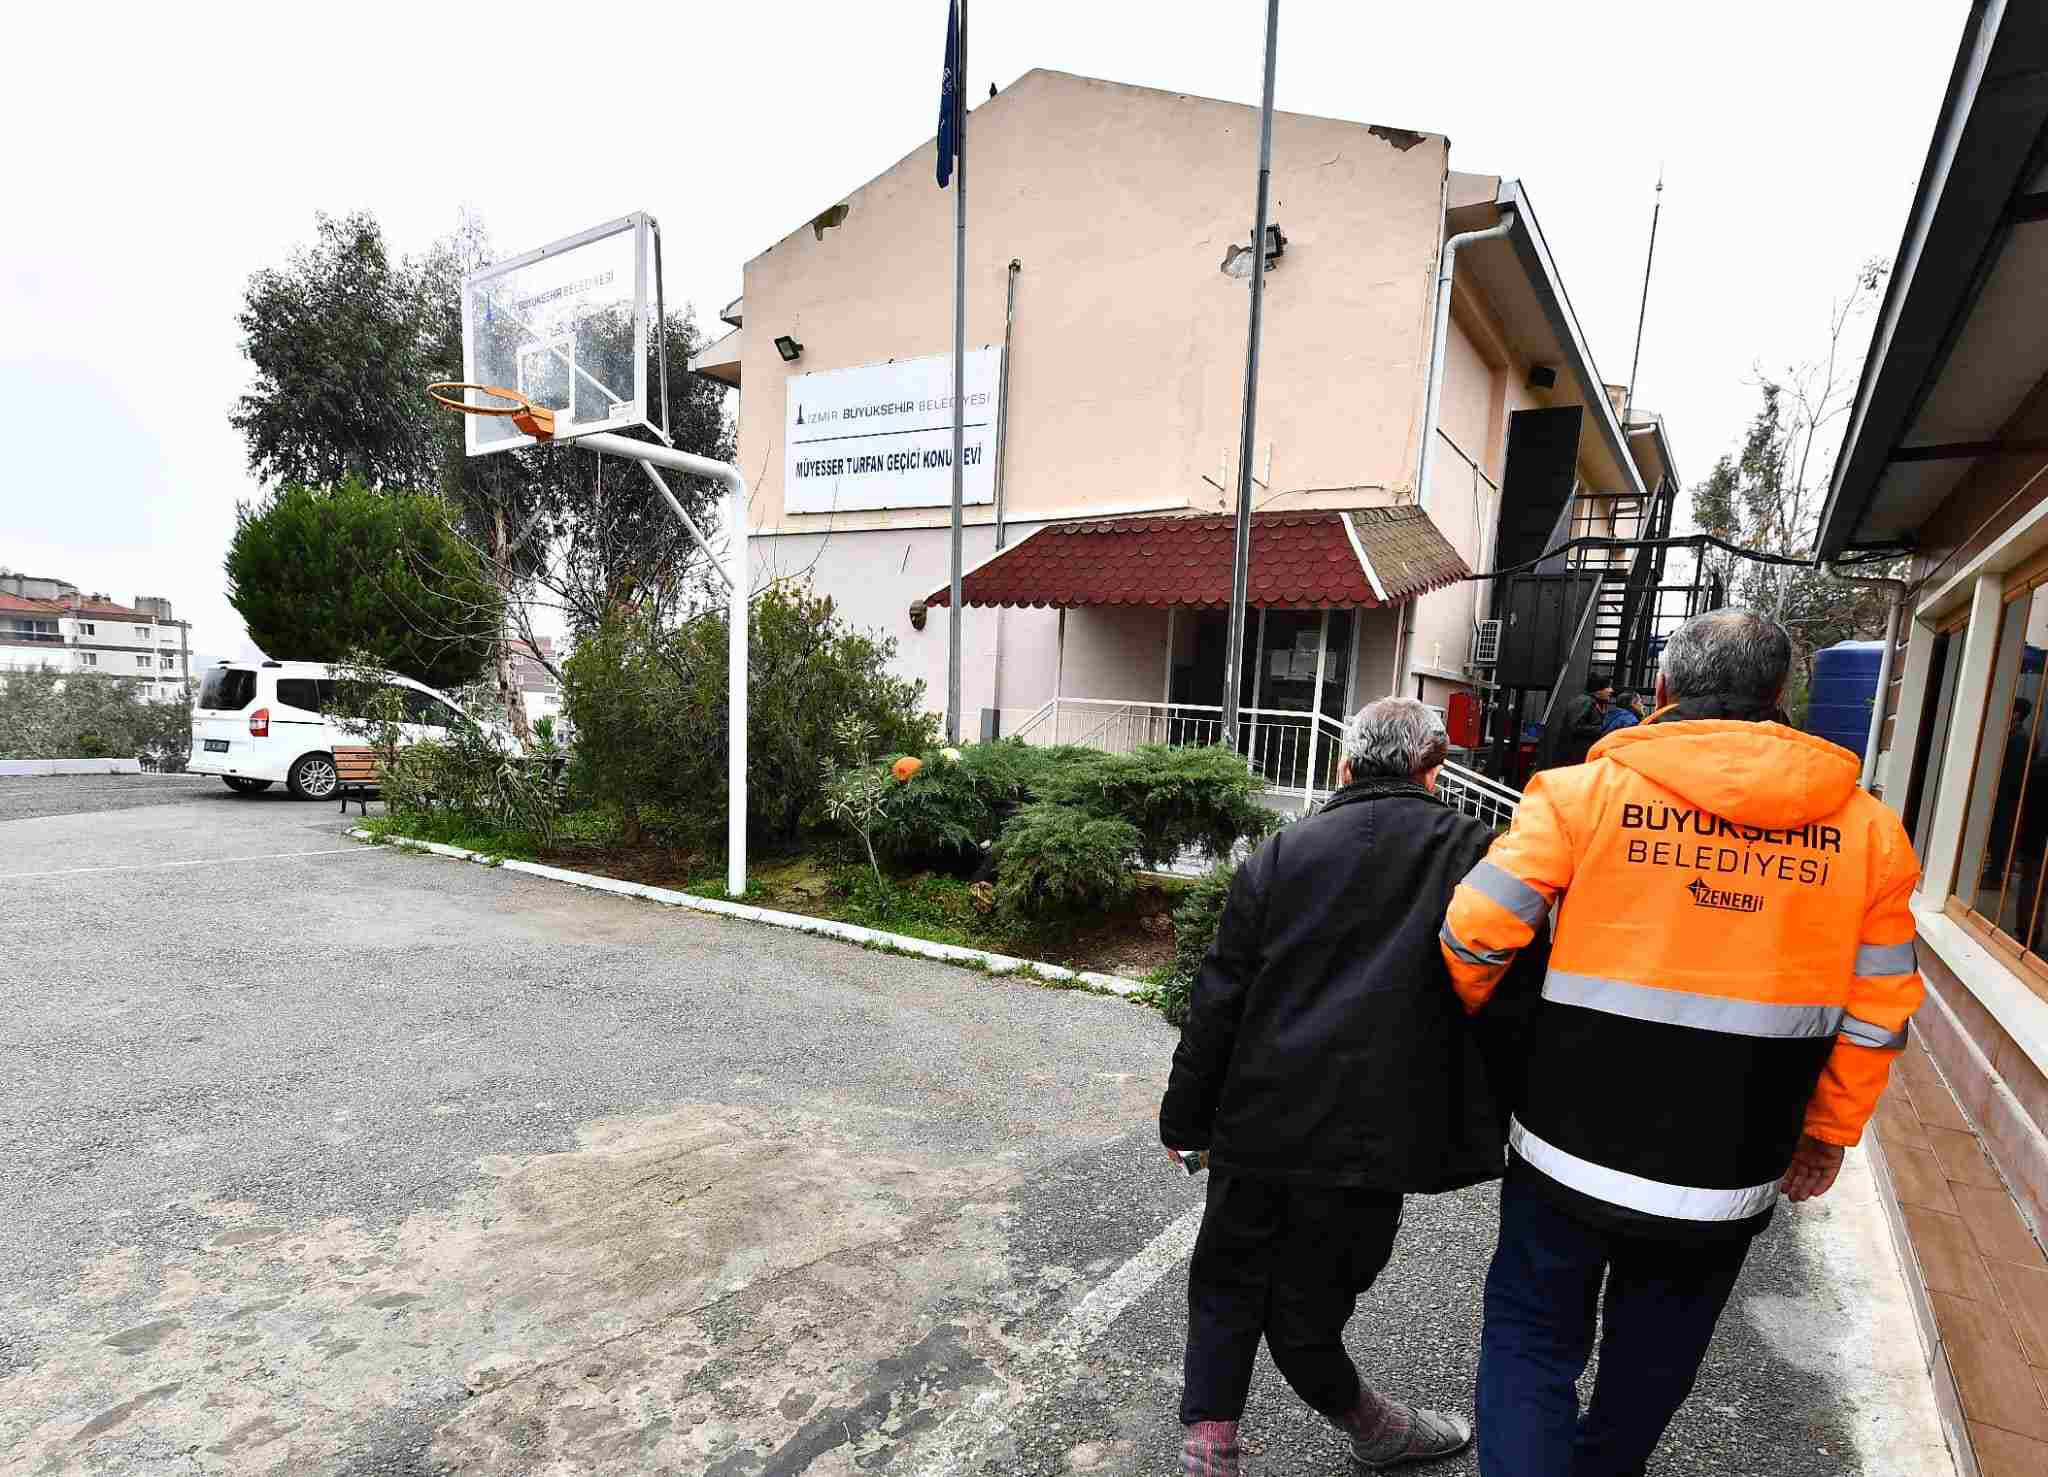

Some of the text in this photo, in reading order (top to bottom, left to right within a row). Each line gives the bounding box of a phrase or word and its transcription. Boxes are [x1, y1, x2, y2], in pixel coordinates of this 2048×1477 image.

[796, 457, 844, 479] MÜYESSER
[847, 455, 884, 474] TURFAN
[886, 448, 920, 474] GEÇİCİ
[1627, 839, 1830, 886] BELEDİYESİ
